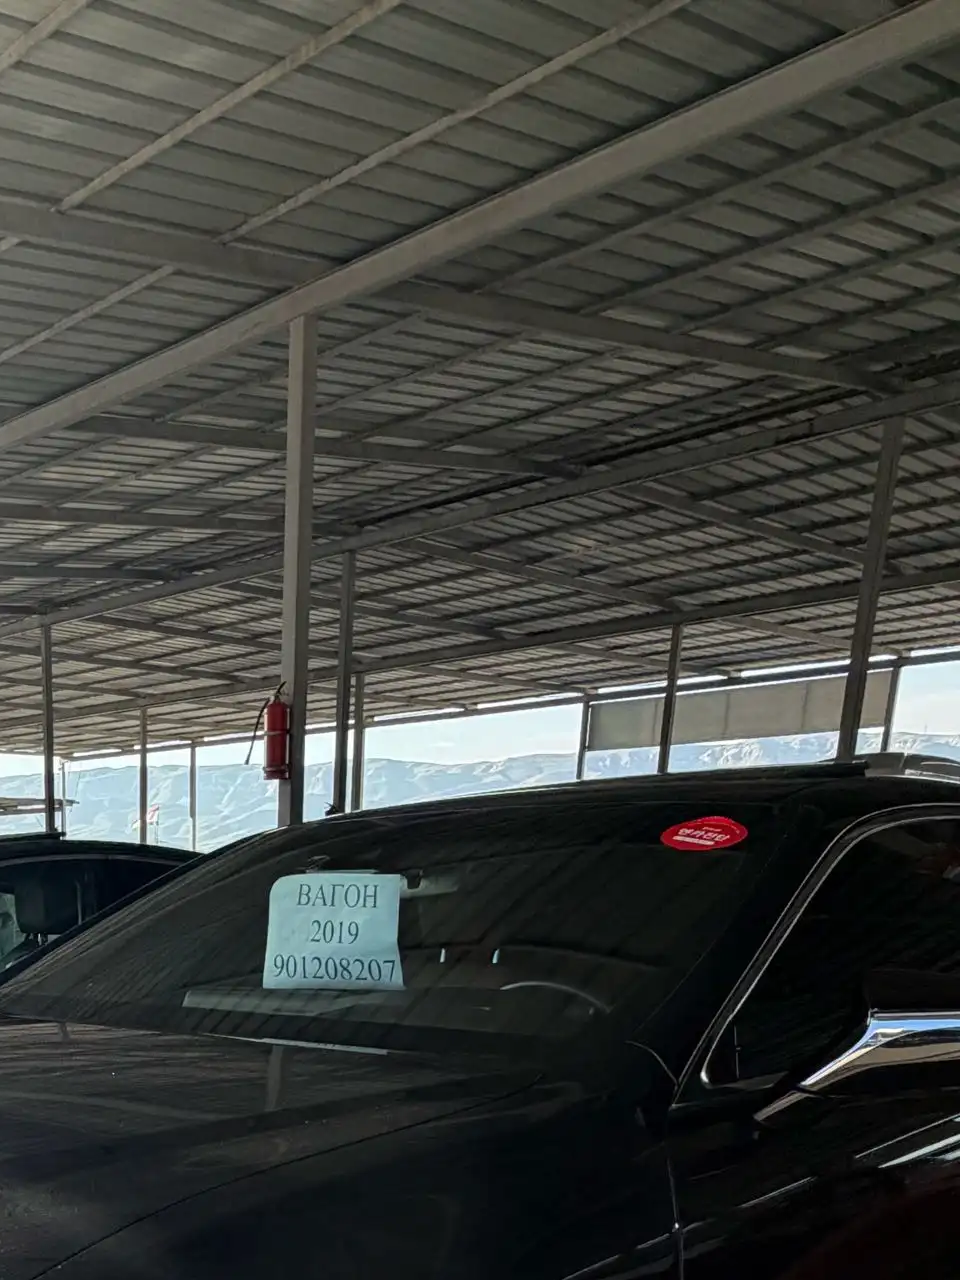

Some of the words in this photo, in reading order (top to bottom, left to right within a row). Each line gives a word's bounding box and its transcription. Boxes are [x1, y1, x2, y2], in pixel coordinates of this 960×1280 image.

[296, 883, 380, 908] ВАГОН
[310, 919, 360, 945] 2019
[272, 953, 396, 983] 901208207
